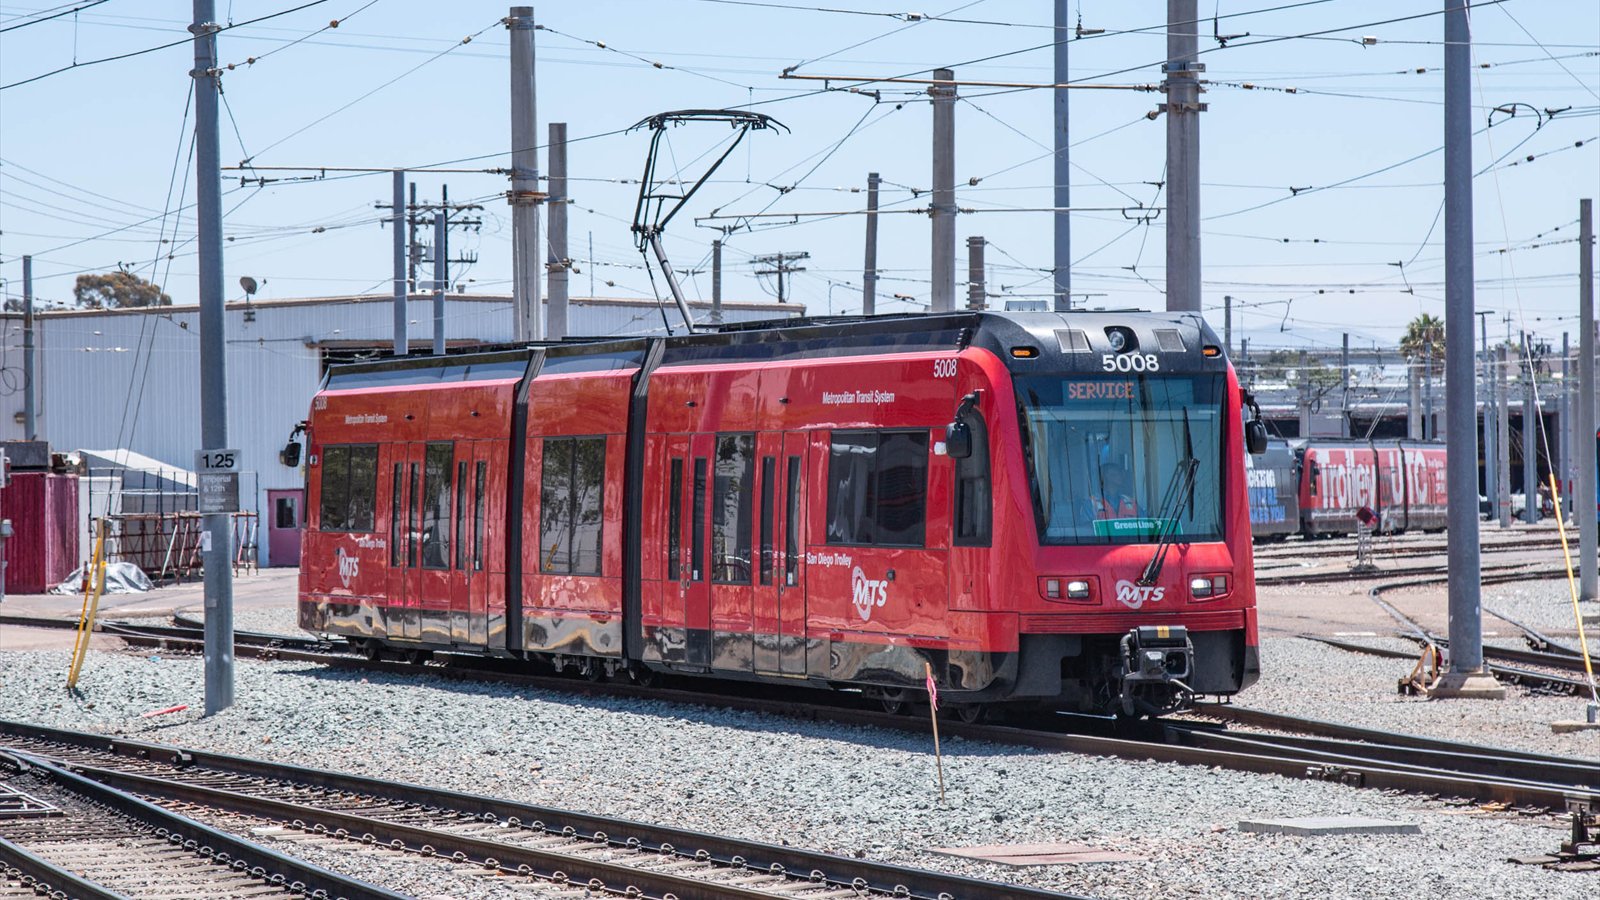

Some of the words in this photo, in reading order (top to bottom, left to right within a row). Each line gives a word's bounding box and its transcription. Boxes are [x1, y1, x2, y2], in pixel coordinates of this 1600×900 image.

[933, 359, 957, 378] 5008
[1102, 354, 1160, 372] 5008
[822, 391, 855, 406] Metropolitan
[856, 390, 873, 403] Transit
[874, 389, 895, 405] System
[1068, 382, 1135, 399] SERVICE
[345, 414, 364, 426] Metropolitan
[364, 413, 375, 424] Transit
[375, 412, 388, 424] System
[202, 453, 235, 469] 1.25
[202, 475, 232, 485] Imperial
[1315, 449, 1377, 510] Trolley
[1389, 450, 1428, 504] UTC
[210, 484, 226, 492] 12th
[1114, 521, 1138, 529] Green
[1139, 520, 1155, 529] Line
[339, 556, 360, 577] MTS
[806, 552, 817, 565] San
[818, 552, 833, 568] Diego
[834, 553, 852, 568] Trolley
[852, 580, 888, 607] MTS
[1116, 586, 1165, 602] MTS
